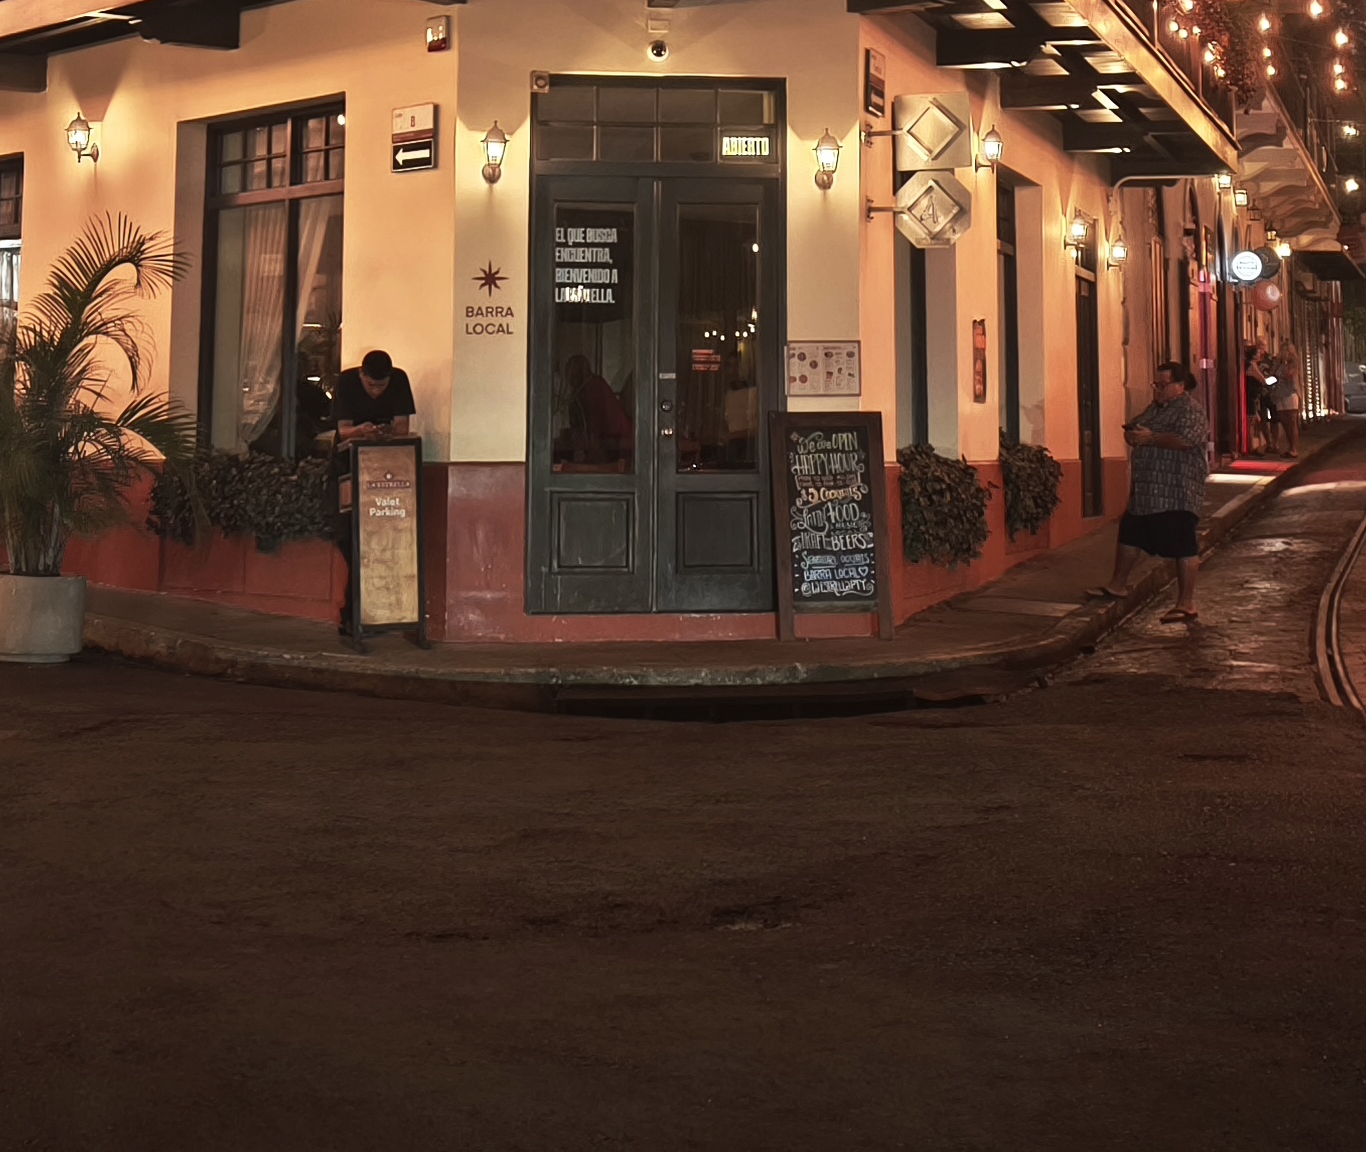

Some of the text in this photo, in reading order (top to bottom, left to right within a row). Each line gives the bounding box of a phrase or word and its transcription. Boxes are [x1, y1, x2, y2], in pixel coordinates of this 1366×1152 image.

[722, 136, 770, 156] ABIERTO
[555, 228, 618, 245] EL QUE BUSCA
[555, 268, 618, 284] BIENVENIDO A
[465, 306, 515, 318] BARRA
[465, 323, 514, 335] LOCAL
[832, 432, 858, 451] OPEN
[793, 452, 861, 476] HAPPY HOUR
[375, 497, 400, 507] Valet
[369, 507, 406, 518] Parking
[831, 533, 866, 551] BEERS
[804, 568, 860, 581] BARRA LOCAL
